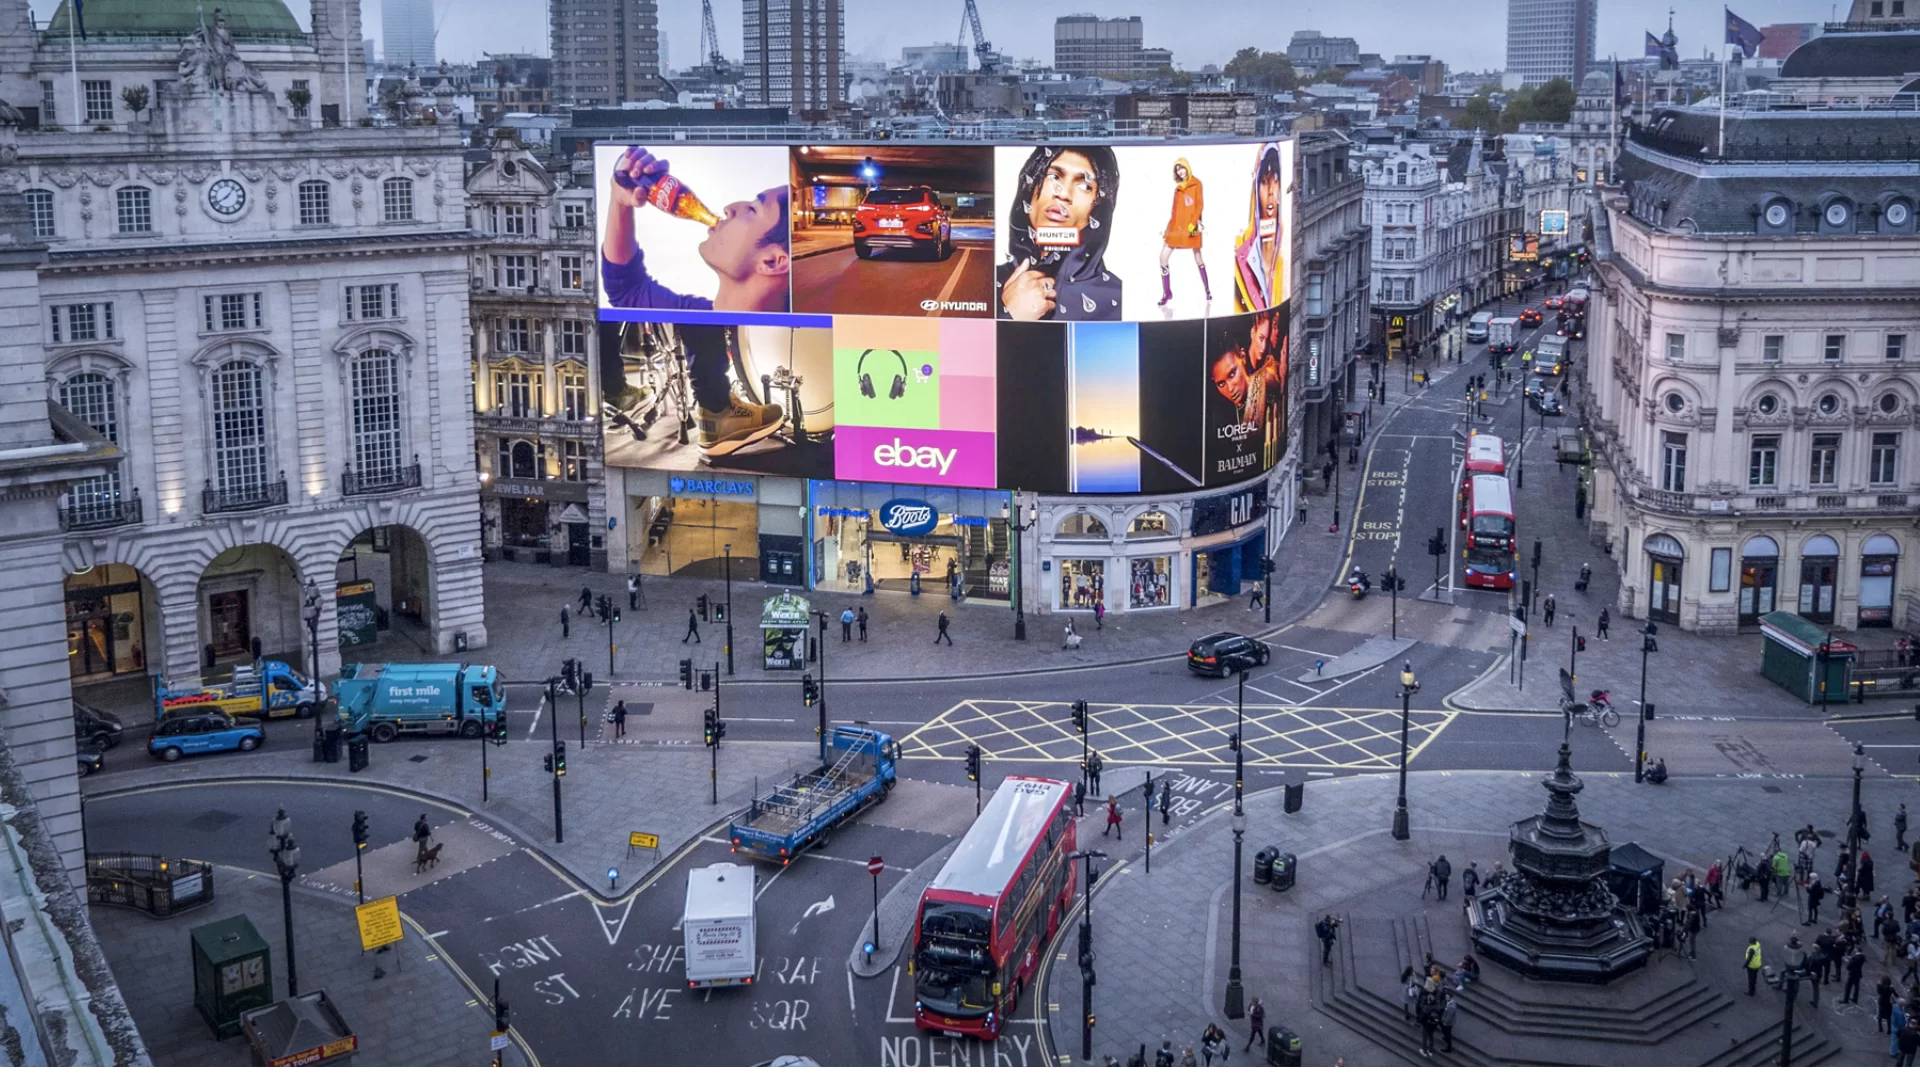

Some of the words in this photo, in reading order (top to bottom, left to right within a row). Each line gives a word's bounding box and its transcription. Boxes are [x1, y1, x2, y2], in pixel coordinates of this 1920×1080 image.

[1039, 231, 1076, 239] HUNTER
[940, 301, 988, 313] HYUNDAI
[1231, 433, 1248, 442] PARIS
[873, 437, 958, 476] ebay
[1216, 451, 1258, 473] BALMAIN
[492, 483, 522, 494] JEWEL
[523, 485, 545, 496] BAR
[687, 478, 754, 496] BARCLAYS
[1366, 479, 1400, 487] STOP
[818, 507, 870, 519] pharmacy
[885, 504, 931, 530] Boots
[1231, 493, 1254, 525] GAP
[1356, 531, 1395, 540] STOP
[269, 688, 300, 706] HSS
[389, 686, 413, 697] first
[415, 685, 441, 697] mile
[1169, 773, 1233, 800] LANE
[1153, 792, 1203, 817] BUS
[970, 949, 983, 960] 14
[533, 972, 581, 1005] ST
[611, 987, 682, 1020] AVE
[747, 999, 810, 1032] SQR
[293, 1053, 321, 1068] TOURS
[880, 1035, 921, 1068] NO
